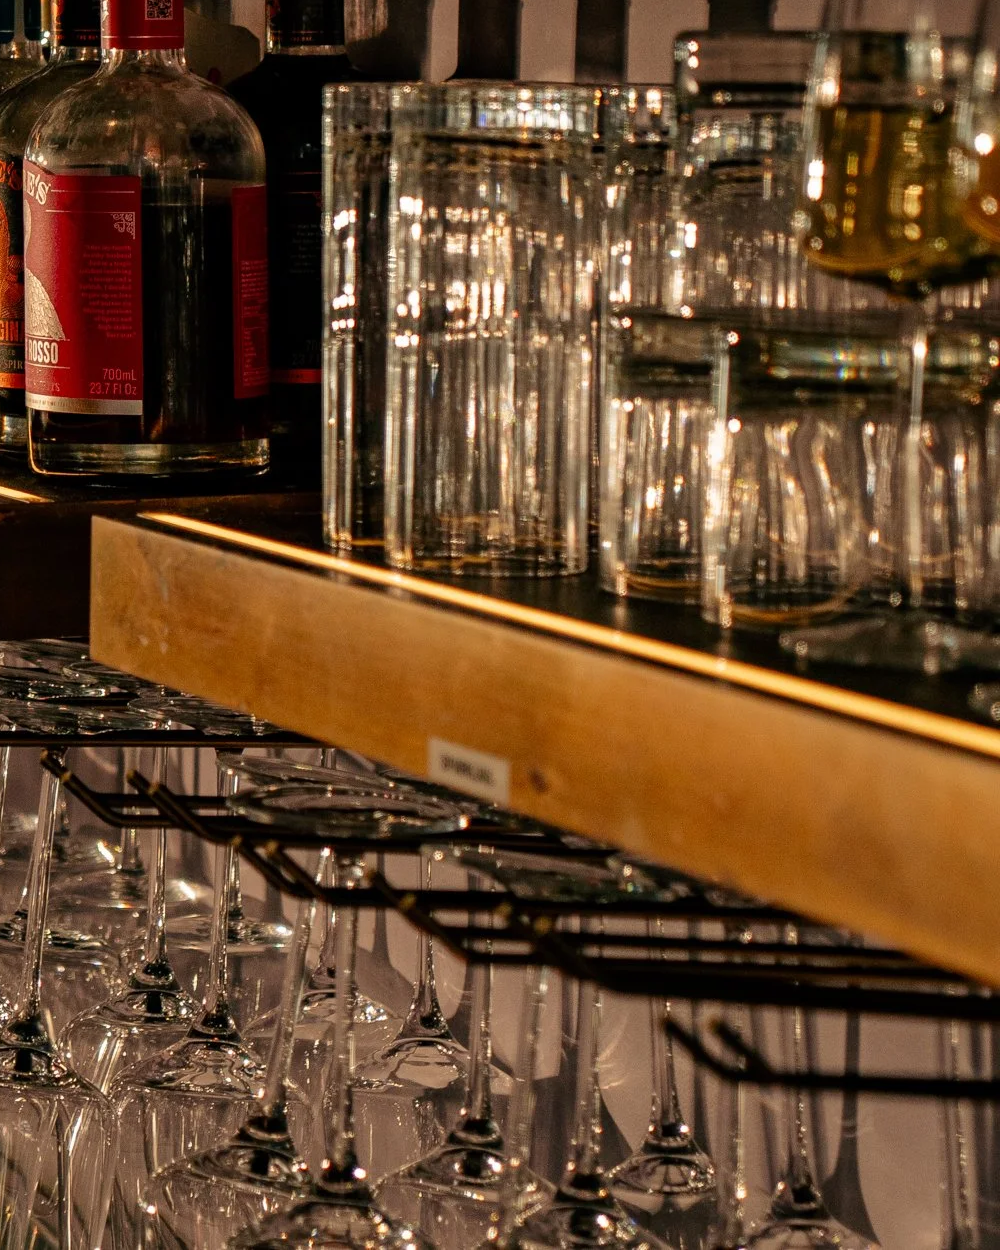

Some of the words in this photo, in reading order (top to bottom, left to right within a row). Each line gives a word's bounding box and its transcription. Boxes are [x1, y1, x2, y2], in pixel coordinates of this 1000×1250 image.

[28, 341, 59, 365] ROSSO
[102, 367, 138, 382] 700mL
[89, 381, 110, 395] 23.7
[124, 383, 138, 397] Oz
